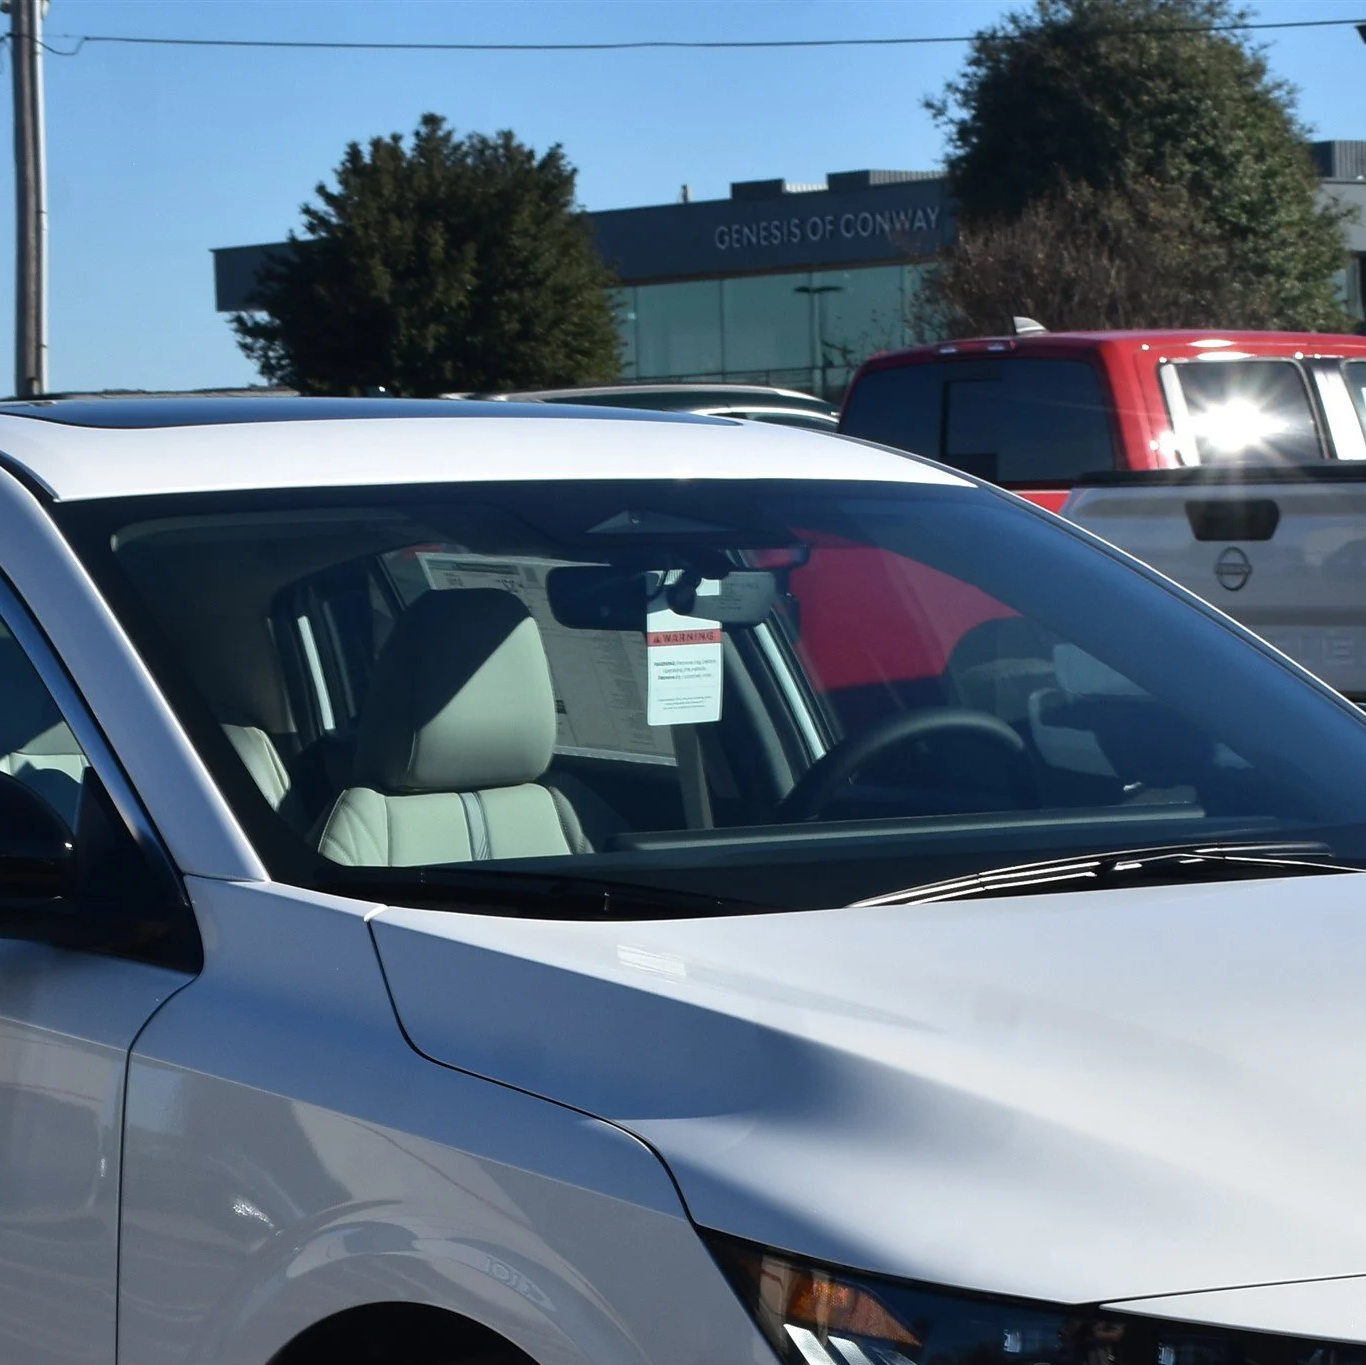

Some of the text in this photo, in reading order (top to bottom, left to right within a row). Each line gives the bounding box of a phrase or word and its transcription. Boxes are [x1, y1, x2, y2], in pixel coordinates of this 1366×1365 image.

[715, 206, 939, 250] GENESIS OF CONWAY
[662, 631, 715, 643] WARNING
